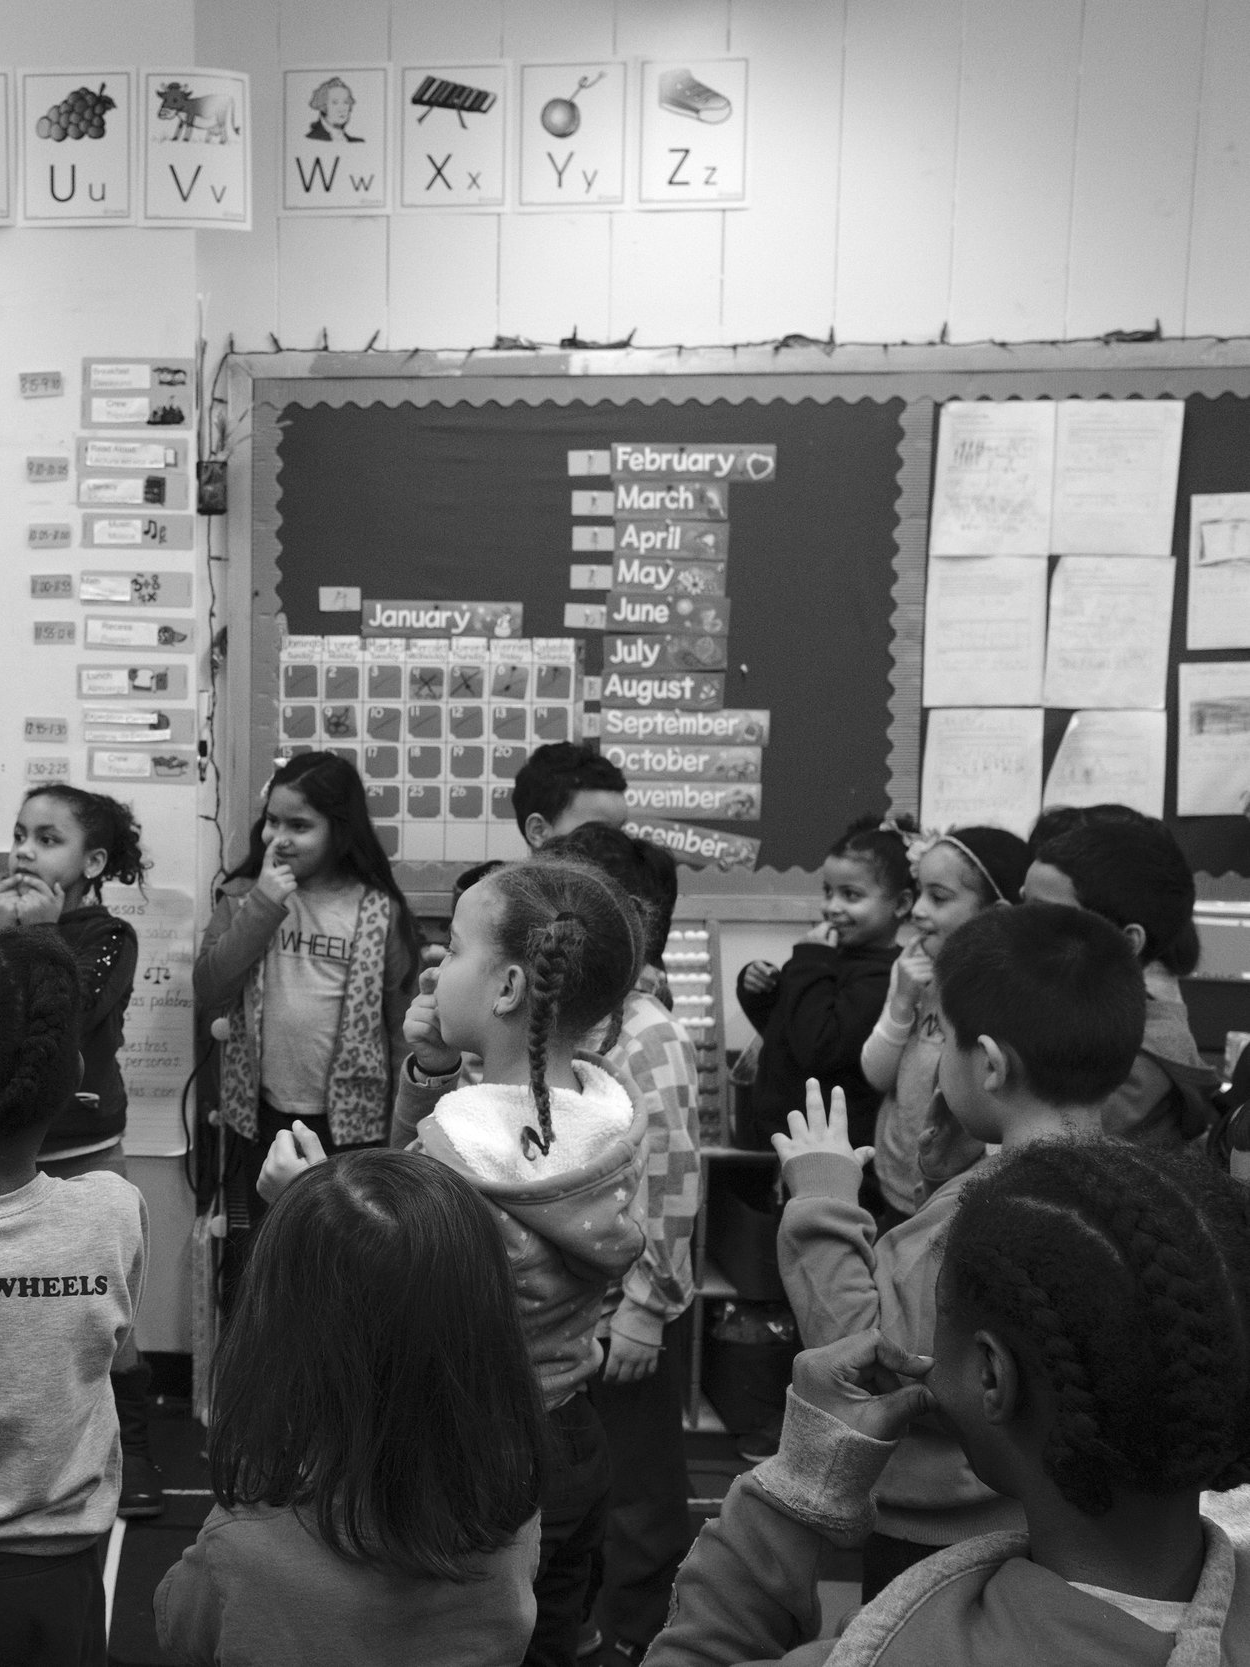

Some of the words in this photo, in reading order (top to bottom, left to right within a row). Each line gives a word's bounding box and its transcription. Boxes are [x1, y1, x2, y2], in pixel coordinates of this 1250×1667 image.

[616, 446, 735, 477] February
[616, 484, 695, 510] March
[619, 523, 682, 555] April
[617, 558, 675, 591] May
[367, 603, 472, 635] January
[612, 596, 670, 623] June
[609, 638, 661, 668] July
[327, 665, 338, 679] 2
[370, 664, 380, 677] 3
[452, 664, 462, 677] 5
[538, 664, 548, 677] 7
[603, 673, 696, 705] August
[323, 704, 333, 718] 9
[369, 705, 385, 719] 10
[410, 704, 421, 718] 11
[451, 706, 465, 719] 12
[606, 709, 740, 740] September
[606, 746, 711, 773] October
[367, 785, 384, 798] 24
[450, 785, 467, 798] 26
[493, 786, 509, 799] 27
[624, 785, 726, 809] ovember
[622, 822, 729, 860] ecember
[281, 928, 354, 961] WHEEL
